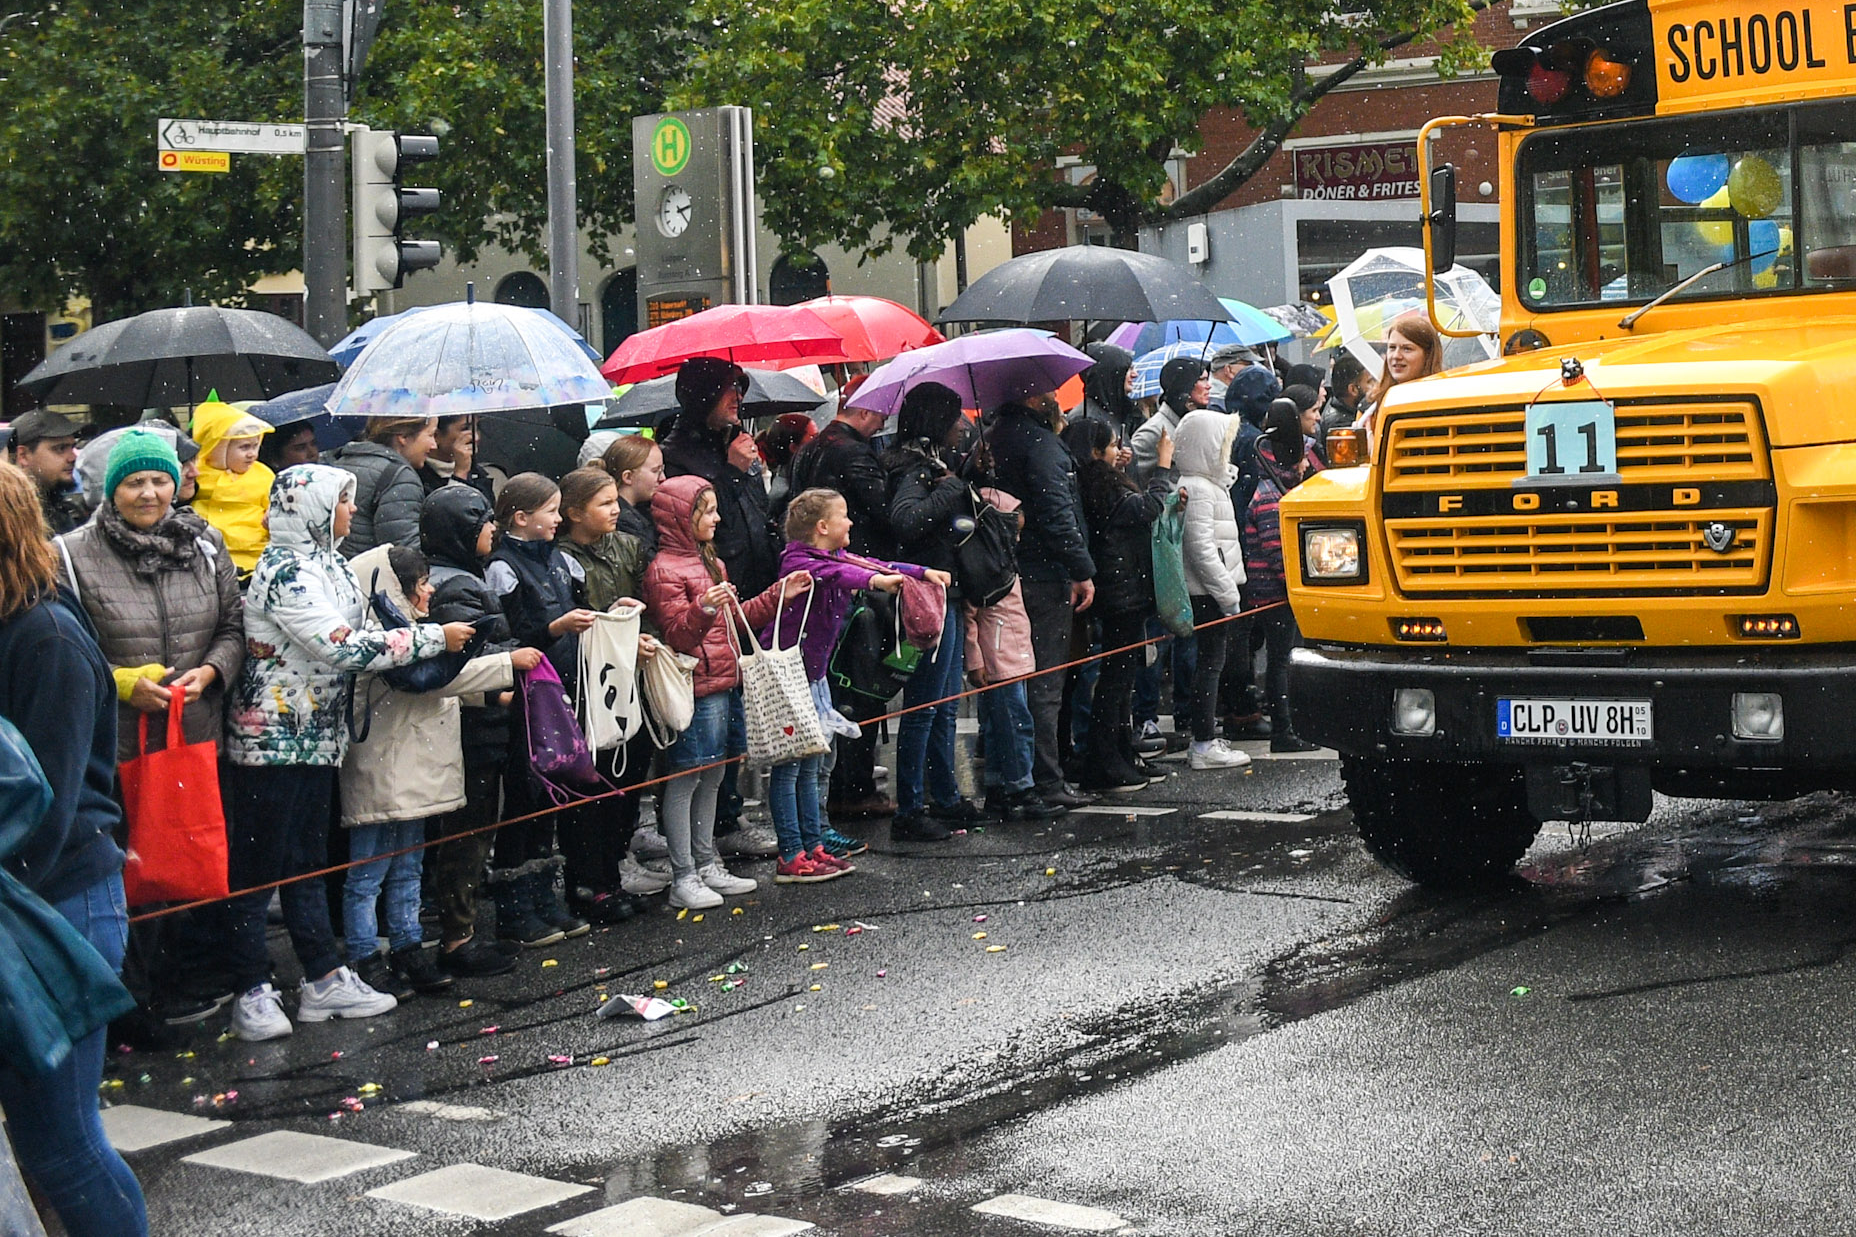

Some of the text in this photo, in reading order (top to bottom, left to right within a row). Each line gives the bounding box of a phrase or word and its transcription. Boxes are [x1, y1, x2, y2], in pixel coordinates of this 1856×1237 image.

[1668, 9, 1826, 82] SCHOOL
[198, 127, 261, 136] Hauptbahnhof
[661, 130, 677, 162] H
[184, 155, 226, 167] Wüsting
[1301, 147, 1418, 184] KISMET
[1303, 180, 1421, 200] DÖNER & FRITES
[1537, 421, 1606, 475] 11
[1438, 488, 1701, 513] FORD
[1501, 704, 1634, 734] D CLP UV 8H
[1635, 707, 1646, 715] 05
[1636, 727, 1647, 735] 10
[1505, 737, 1535, 745] MANCHE
[1577, 738, 1609, 747] MANCHE
[1611, 739, 1642, 748] FOLGEN
